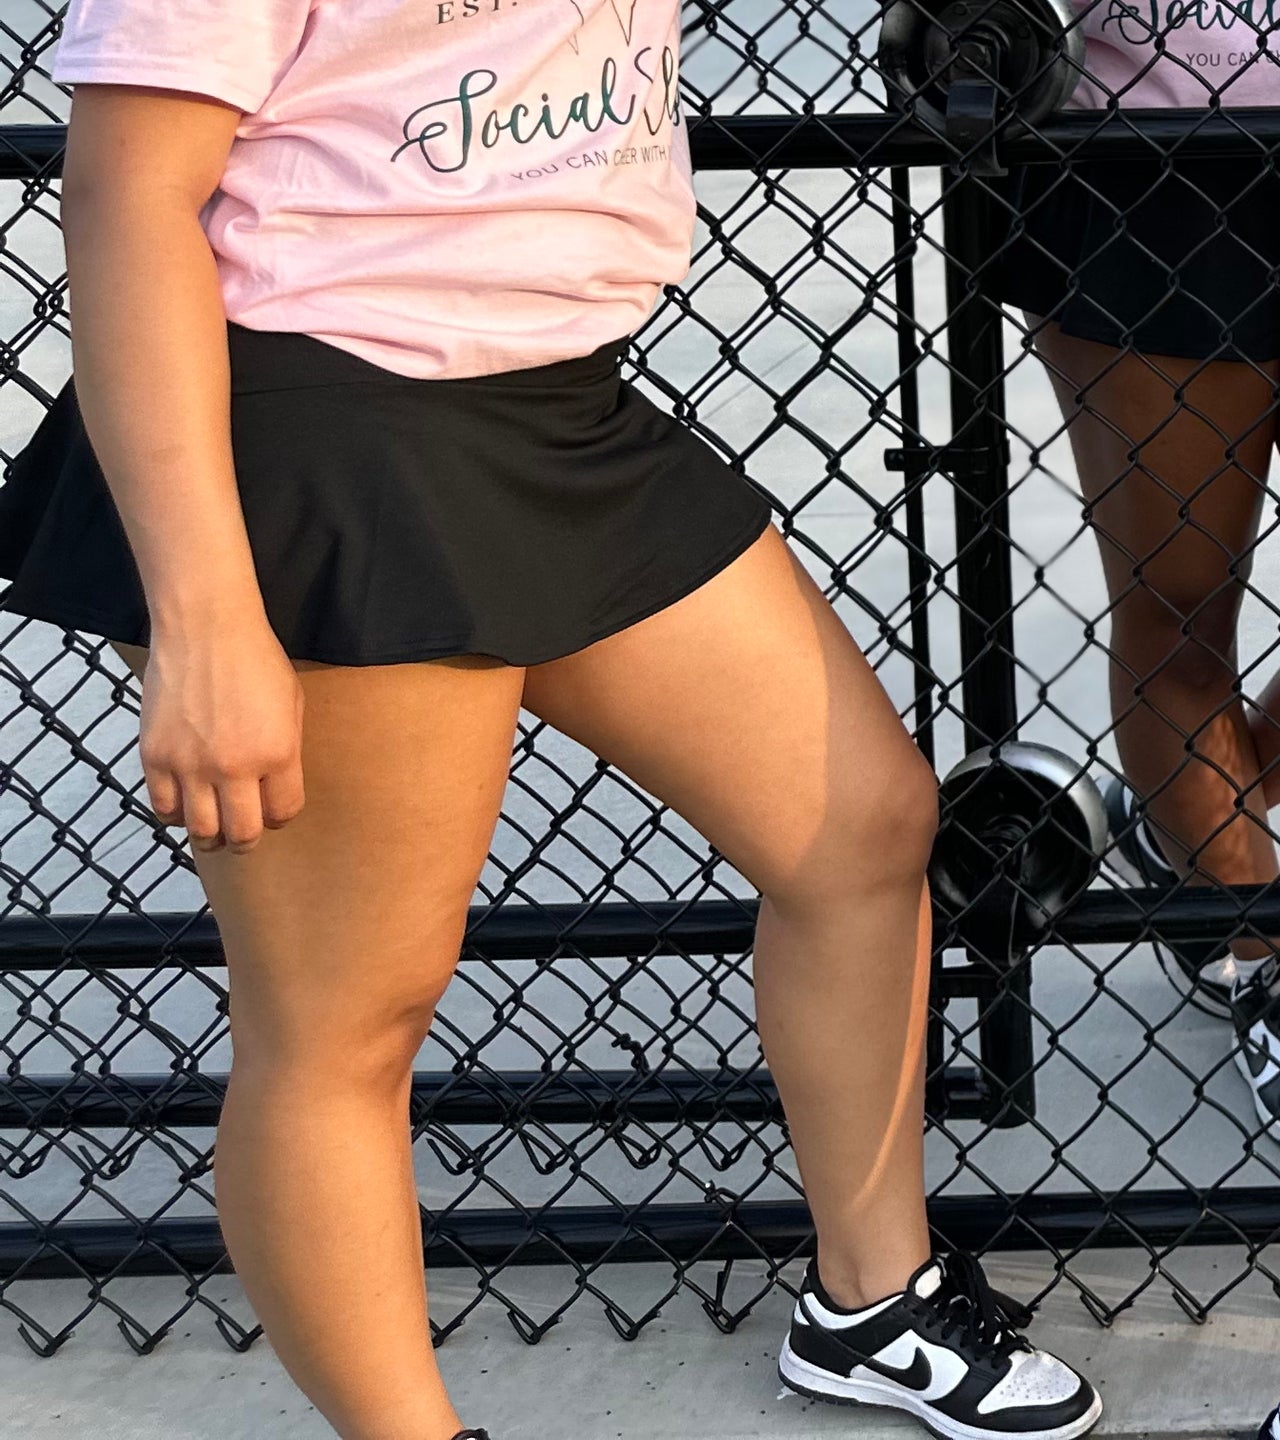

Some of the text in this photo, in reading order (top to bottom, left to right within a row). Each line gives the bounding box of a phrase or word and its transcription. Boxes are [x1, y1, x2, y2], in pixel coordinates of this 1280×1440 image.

[1185, 53, 1221, 68] YOU
[389, 56, 637, 174] Social
[510, 164, 559, 182] YOU
[566, 150, 609, 170] CAN
